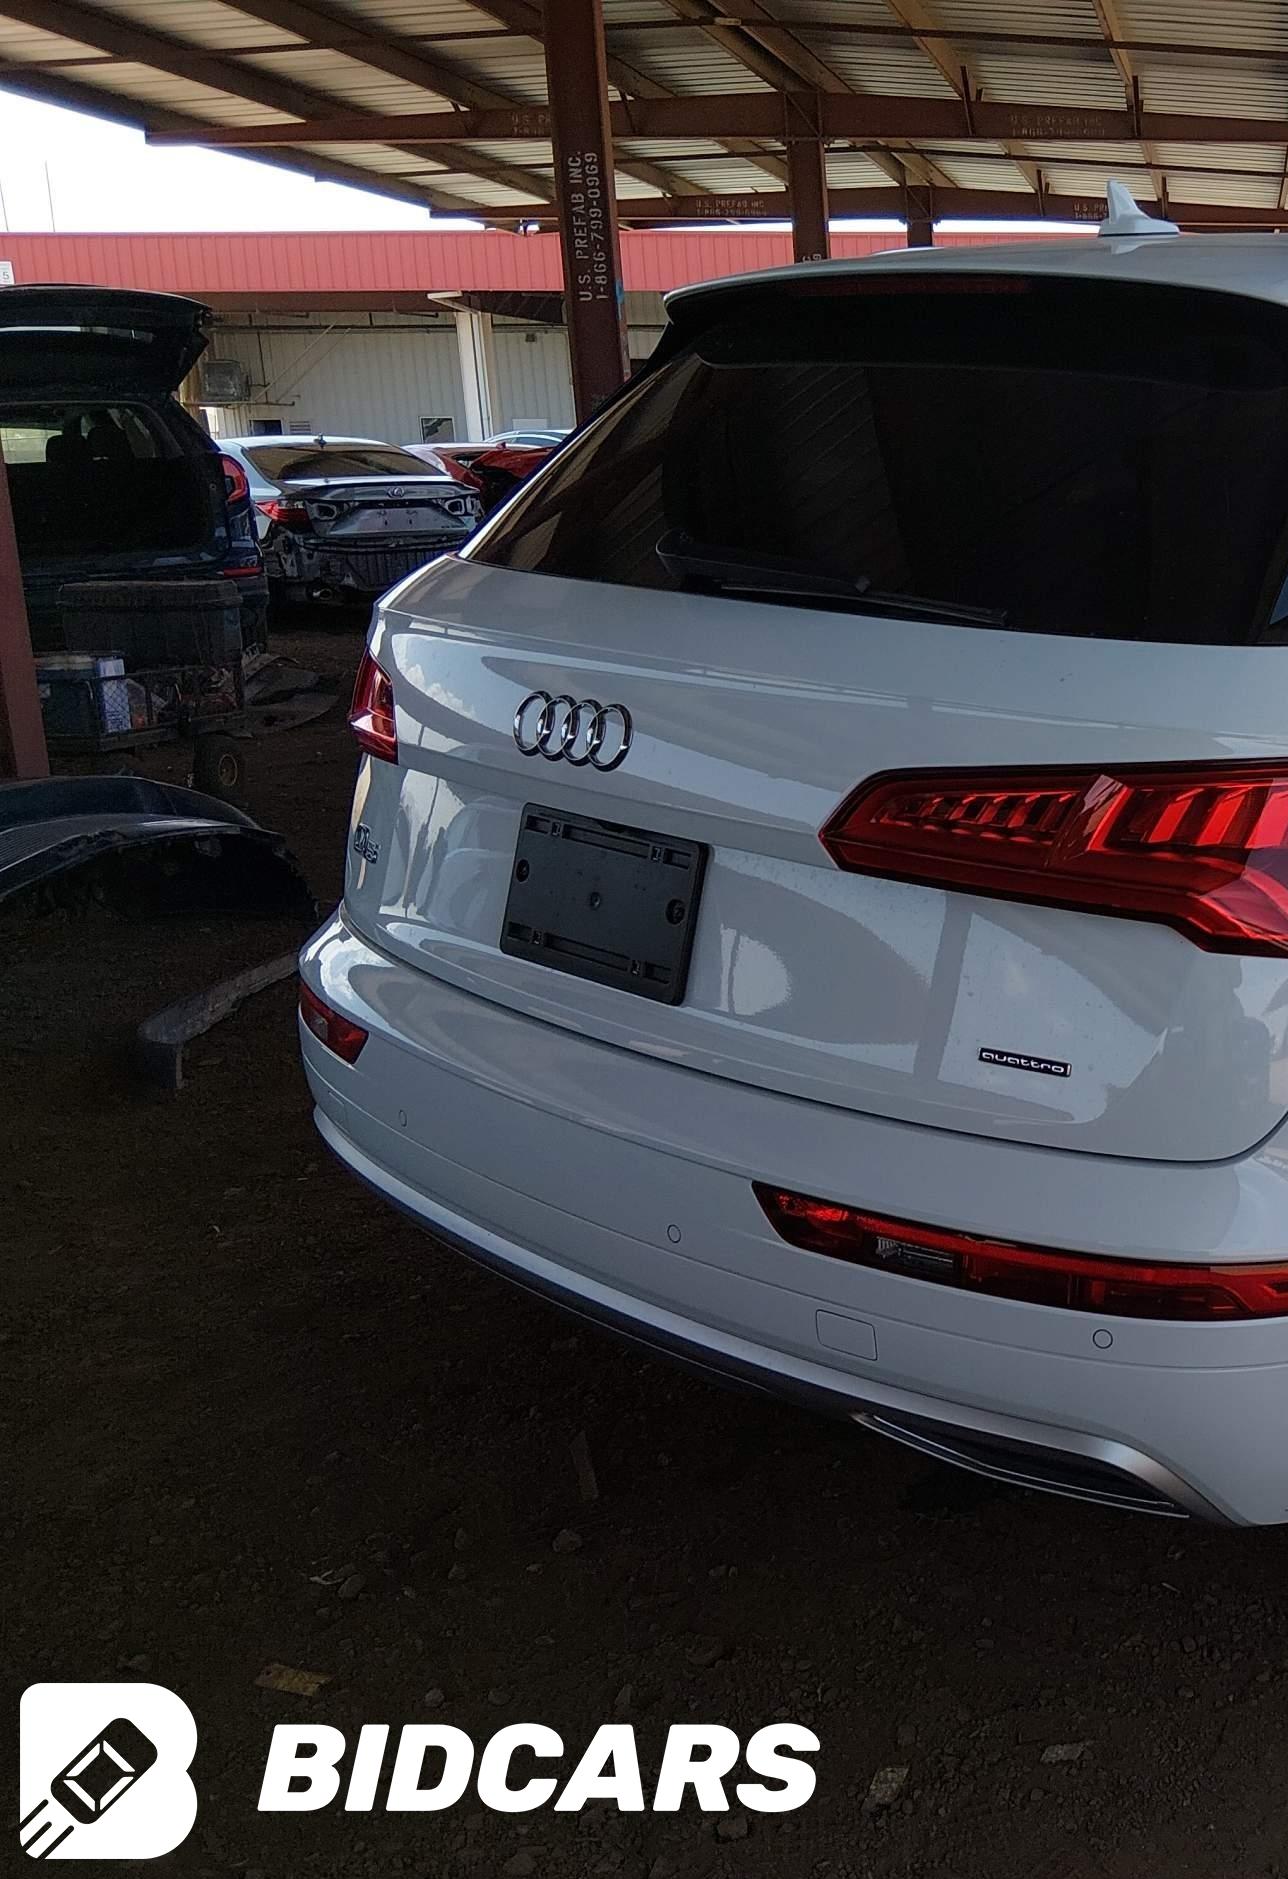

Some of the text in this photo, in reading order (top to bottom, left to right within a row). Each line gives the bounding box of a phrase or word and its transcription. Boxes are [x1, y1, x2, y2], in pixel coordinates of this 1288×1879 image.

[568, 151, 593, 301] U.S. PREFAB INC.
[584, 152, 608, 300] 1-866-799-0969
[981, 1051, 1065, 1074] quattro
